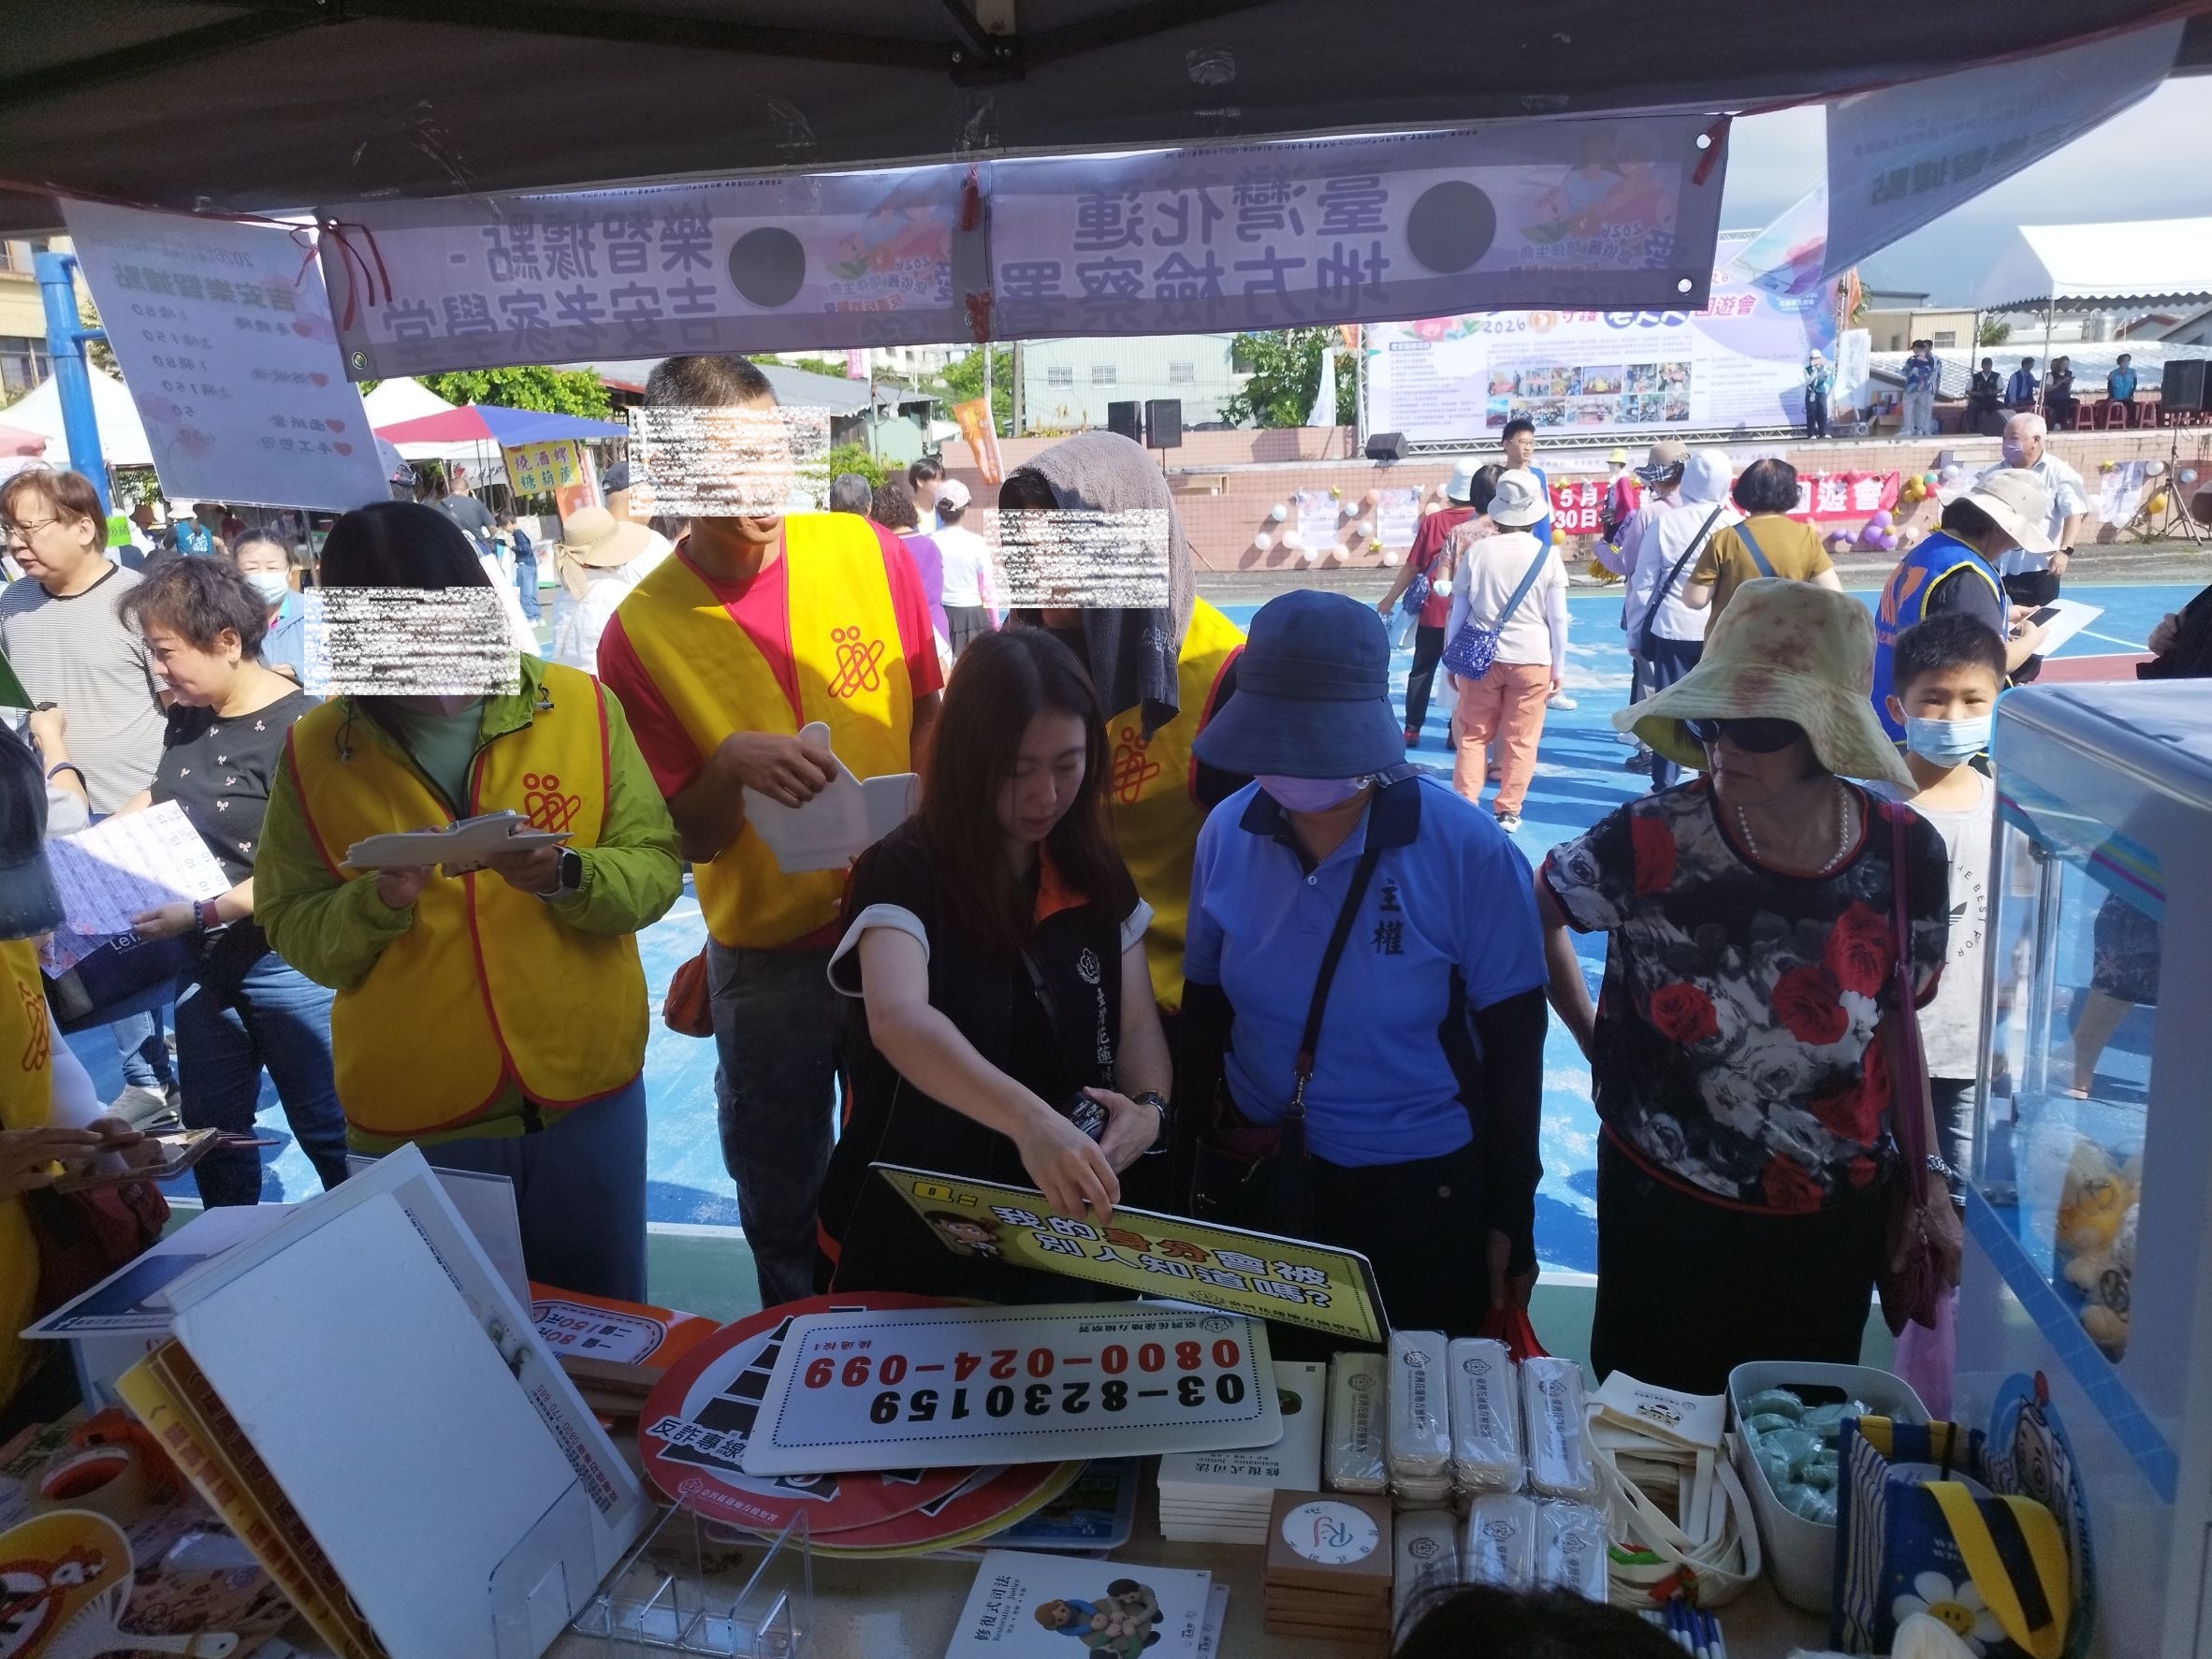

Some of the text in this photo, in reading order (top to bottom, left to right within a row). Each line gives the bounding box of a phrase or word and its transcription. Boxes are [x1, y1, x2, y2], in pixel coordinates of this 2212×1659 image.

[1482, 316, 1527, 334] 2026
[515, 447, 570, 472] 燒酒螺
[1555, 509, 1598, 529] 30日
[1371, 877, 1405, 956] 主權
[1957, 929, 1982, 957] FOR
[989, 1204, 1331, 1293] 我的身分會被
[1078, 1320, 1198, 1333] 臺灣花蓮地方檢察署
[802, 1338, 1241, 1390] 0800-024-099
[869, 1373, 1246, 1426] 03-8230159
[652, 1418, 749, 1462] 反詐專線
[1195, 1463, 1280, 1477] 修復式司法
[974, 1575, 1012, 1641] 修復式司法
